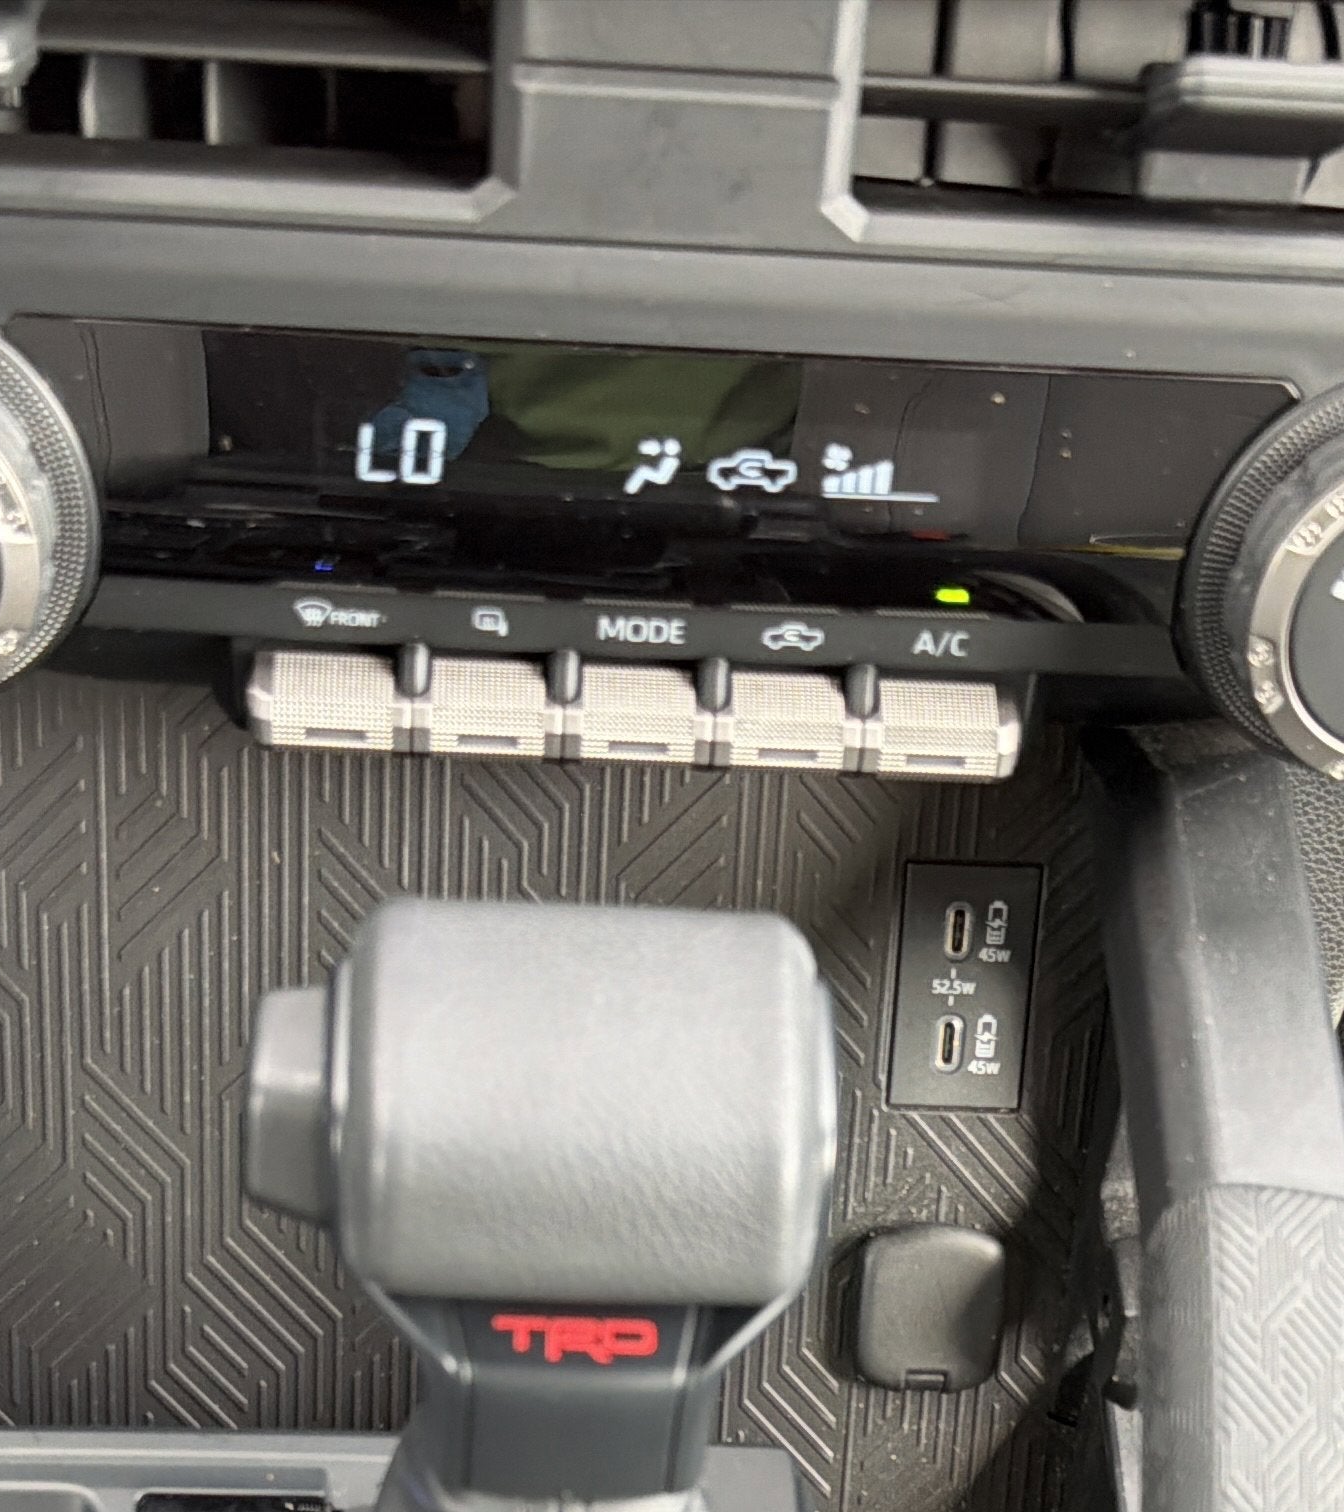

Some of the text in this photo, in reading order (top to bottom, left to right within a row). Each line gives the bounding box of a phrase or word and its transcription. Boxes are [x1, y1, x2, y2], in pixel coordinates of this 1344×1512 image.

[329, 609, 382, 628] FRONT
[596, 615, 686, 645] MODE
[912, 629, 970, 657] A/C
[978, 948, 1011, 963] 45W
[931, 978, 977, 996] 52.5W
[967, 1059, 1001, 1076] 45W
[490, 1313, 659, 1366] TRD
